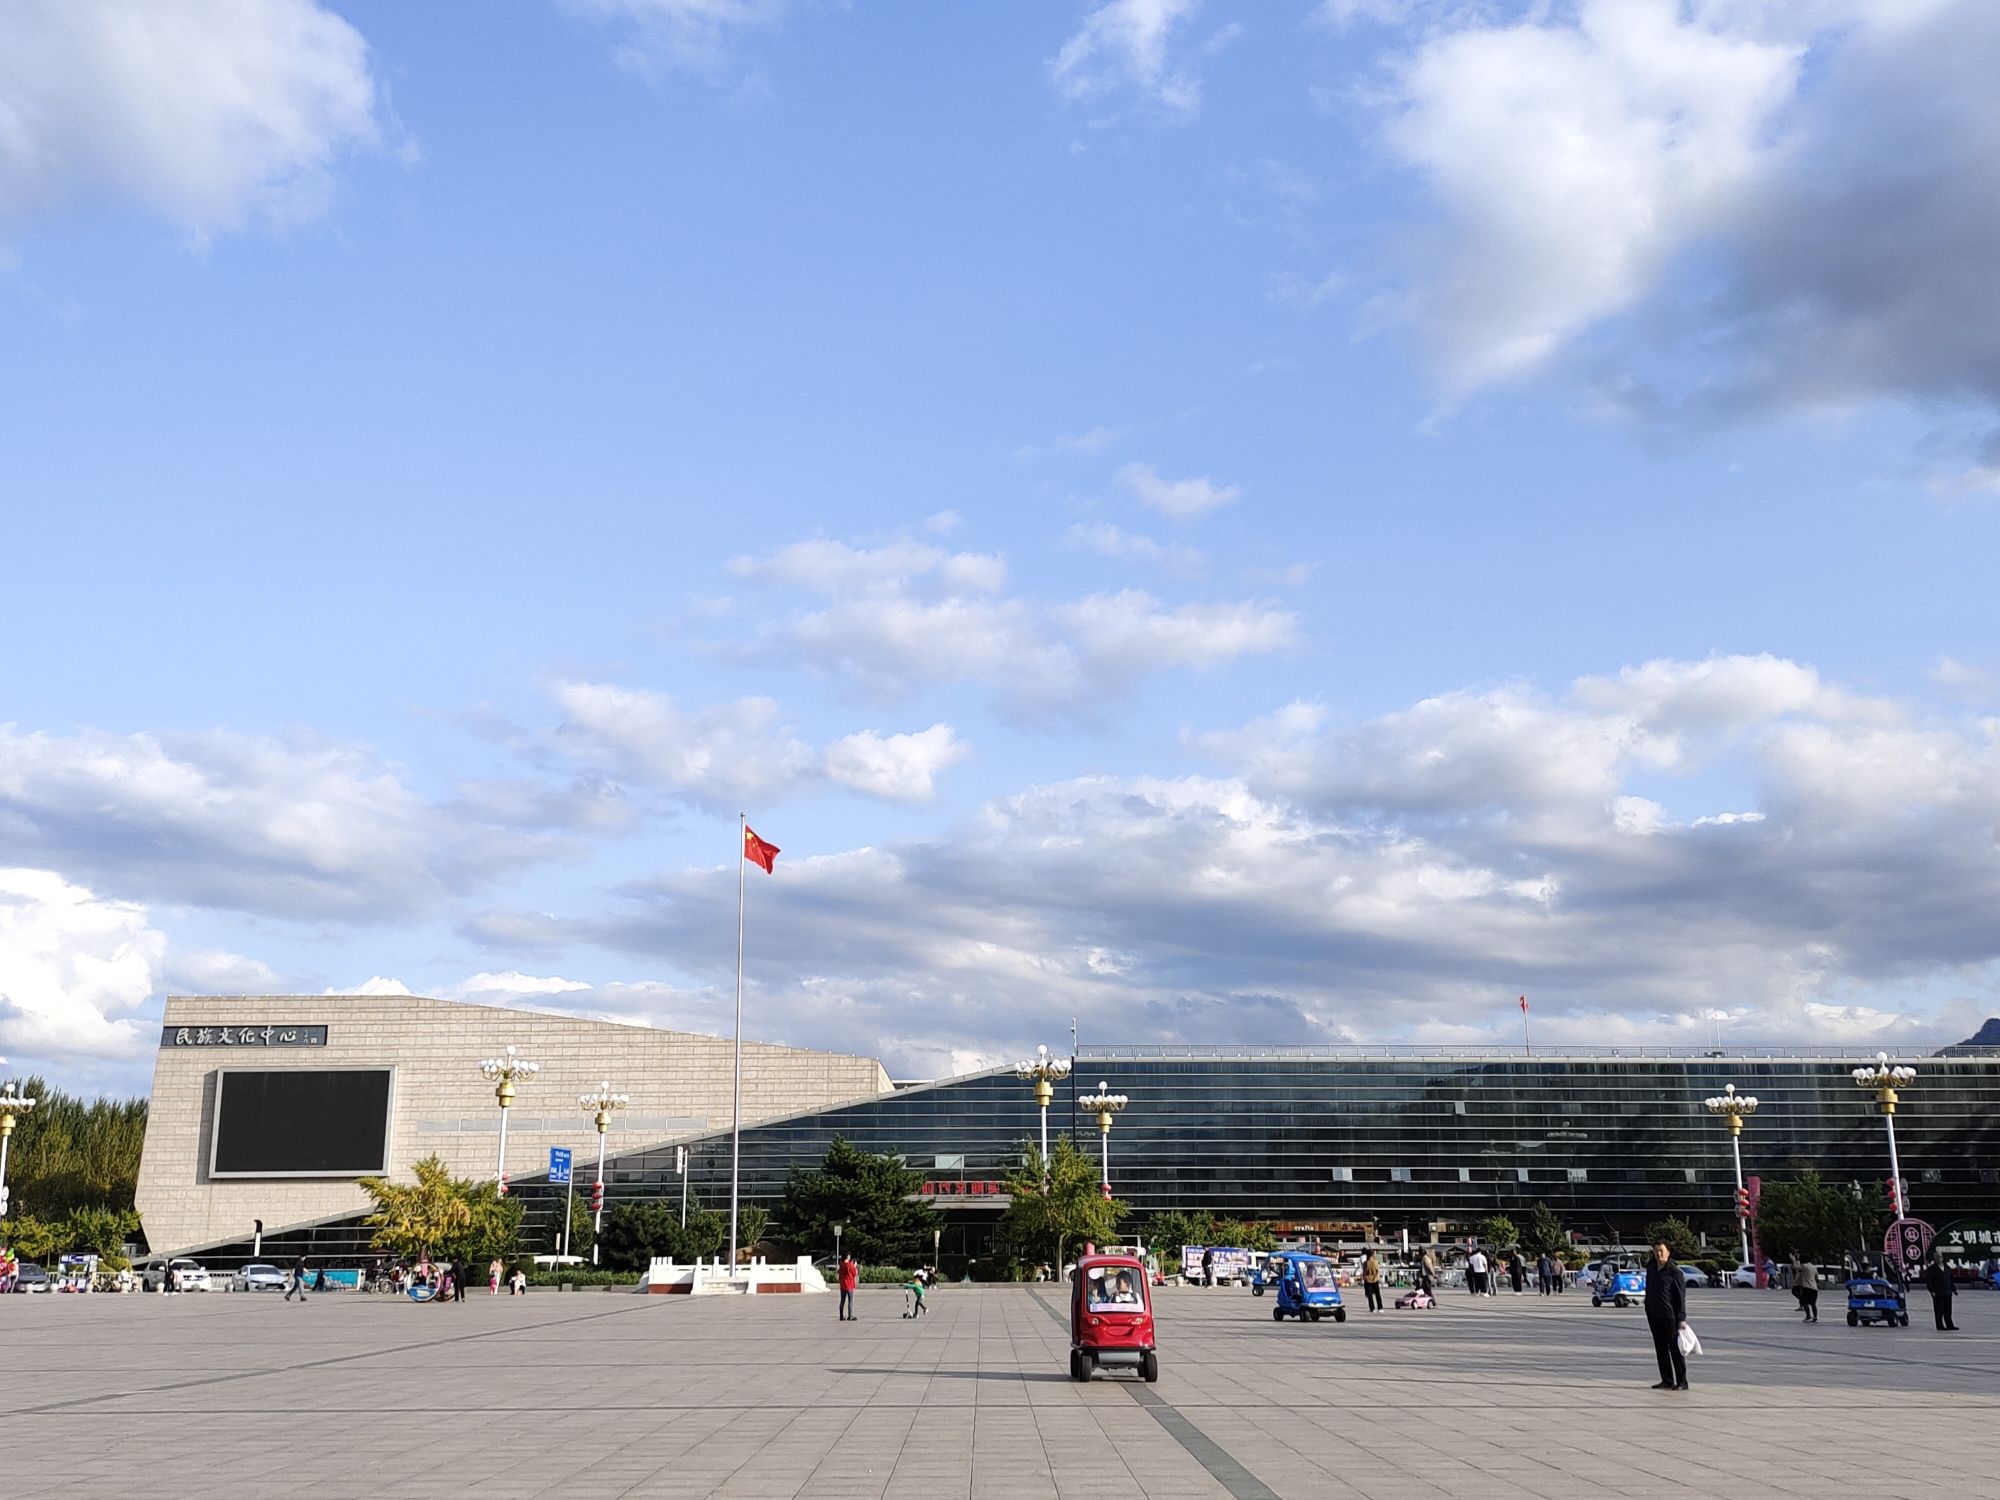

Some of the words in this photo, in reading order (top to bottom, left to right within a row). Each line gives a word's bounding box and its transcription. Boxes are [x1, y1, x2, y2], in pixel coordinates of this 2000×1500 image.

[175, 1026, 296, 1045] 民族文化中心
